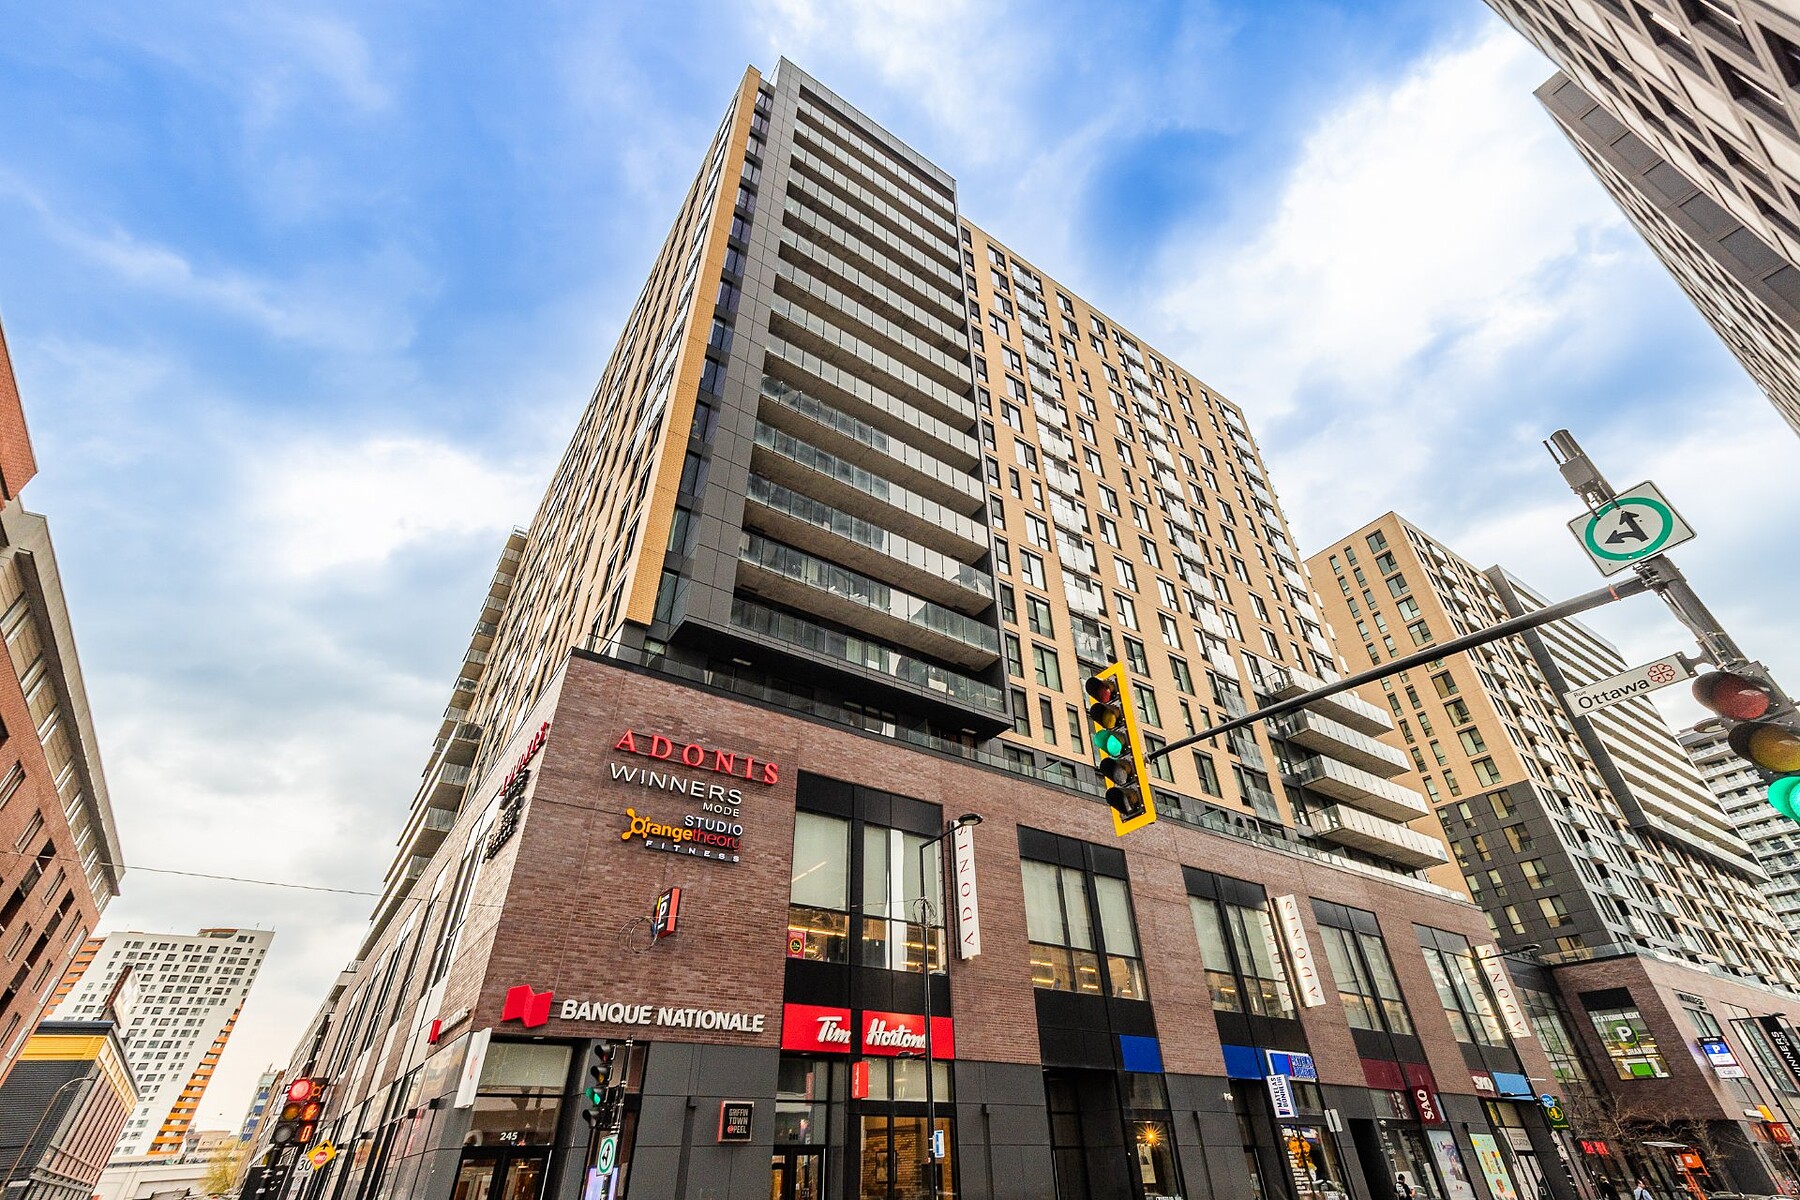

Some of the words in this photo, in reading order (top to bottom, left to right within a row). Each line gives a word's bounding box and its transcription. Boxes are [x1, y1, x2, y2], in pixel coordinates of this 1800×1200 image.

[1573, 690, 1586, 698] Rue
[1578, 678, 1650, 709] Ottawa
[614, 728, 779, 786] ADONIS
[609, 762, 743, 806] WINNERS
[702, 802, 741, 818] MODE
[683, 814, 744, 837] STUDIO
[645, 840, 740, 863] FITNESS
[957, 825, 975, 946] ADONIS
[1285, 901, 1319, 998] ADONIS
[560, 999, 653, 1025] BANQUE
[656, 1007, 766, 1033] NATIONALE
[816, 1015, 852, 1044] Tim
[1616, 1026, 1633, 1042] P
[1270, 1077, 1283, 1108] MATELAS
[1417, 1089, 1435, 1120] SAQ
[500, 1131, 519, 1141] 245
[728, 1117, 749, 1125] TOWN
